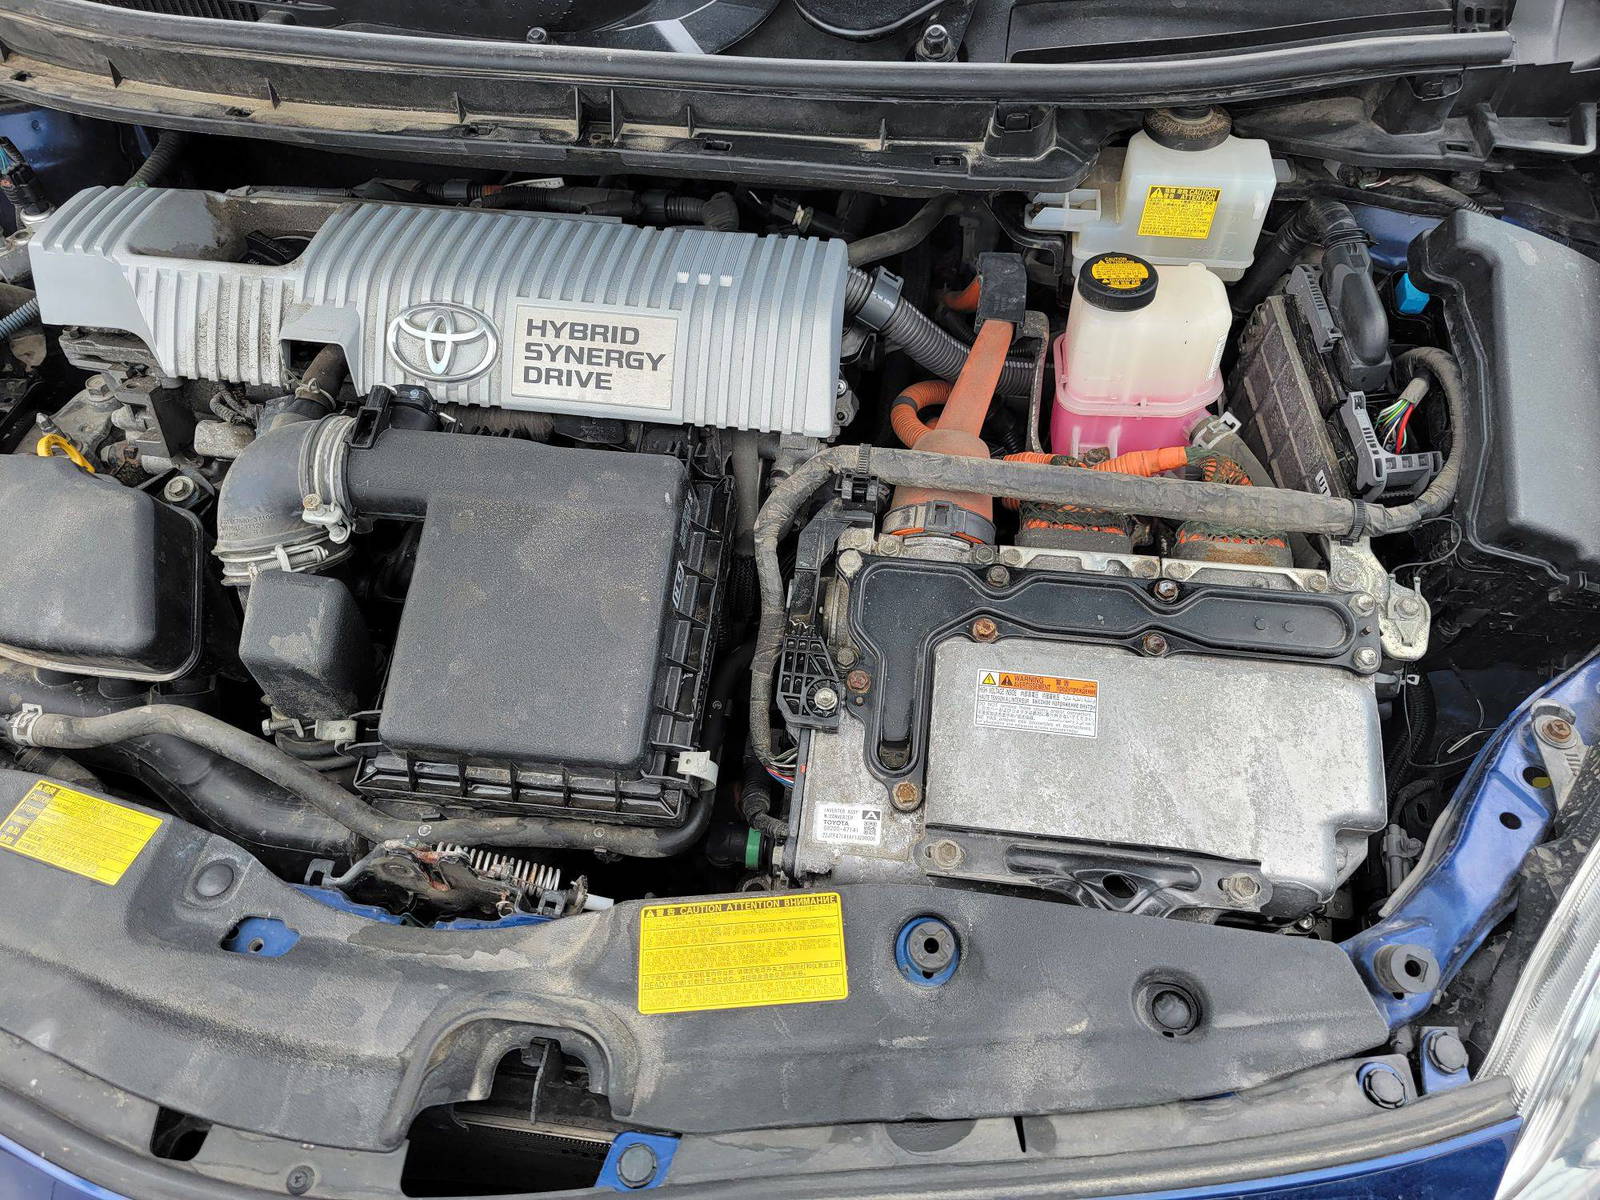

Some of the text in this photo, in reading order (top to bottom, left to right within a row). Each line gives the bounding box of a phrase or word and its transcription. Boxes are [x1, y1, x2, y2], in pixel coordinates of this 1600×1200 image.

[526, 318, 640, 345] HYBRID
[524, 342, 666, 371] SYNERGY
[523, 366, 613, 391] DRIVE
[1014, 675, 1043, 684] WARNING
[679, 904, 722, 915] CAUTION
[726, 898, 780, 912] ATTENTION
[784, 896, 836, 907] ВНИМАНИЕ
